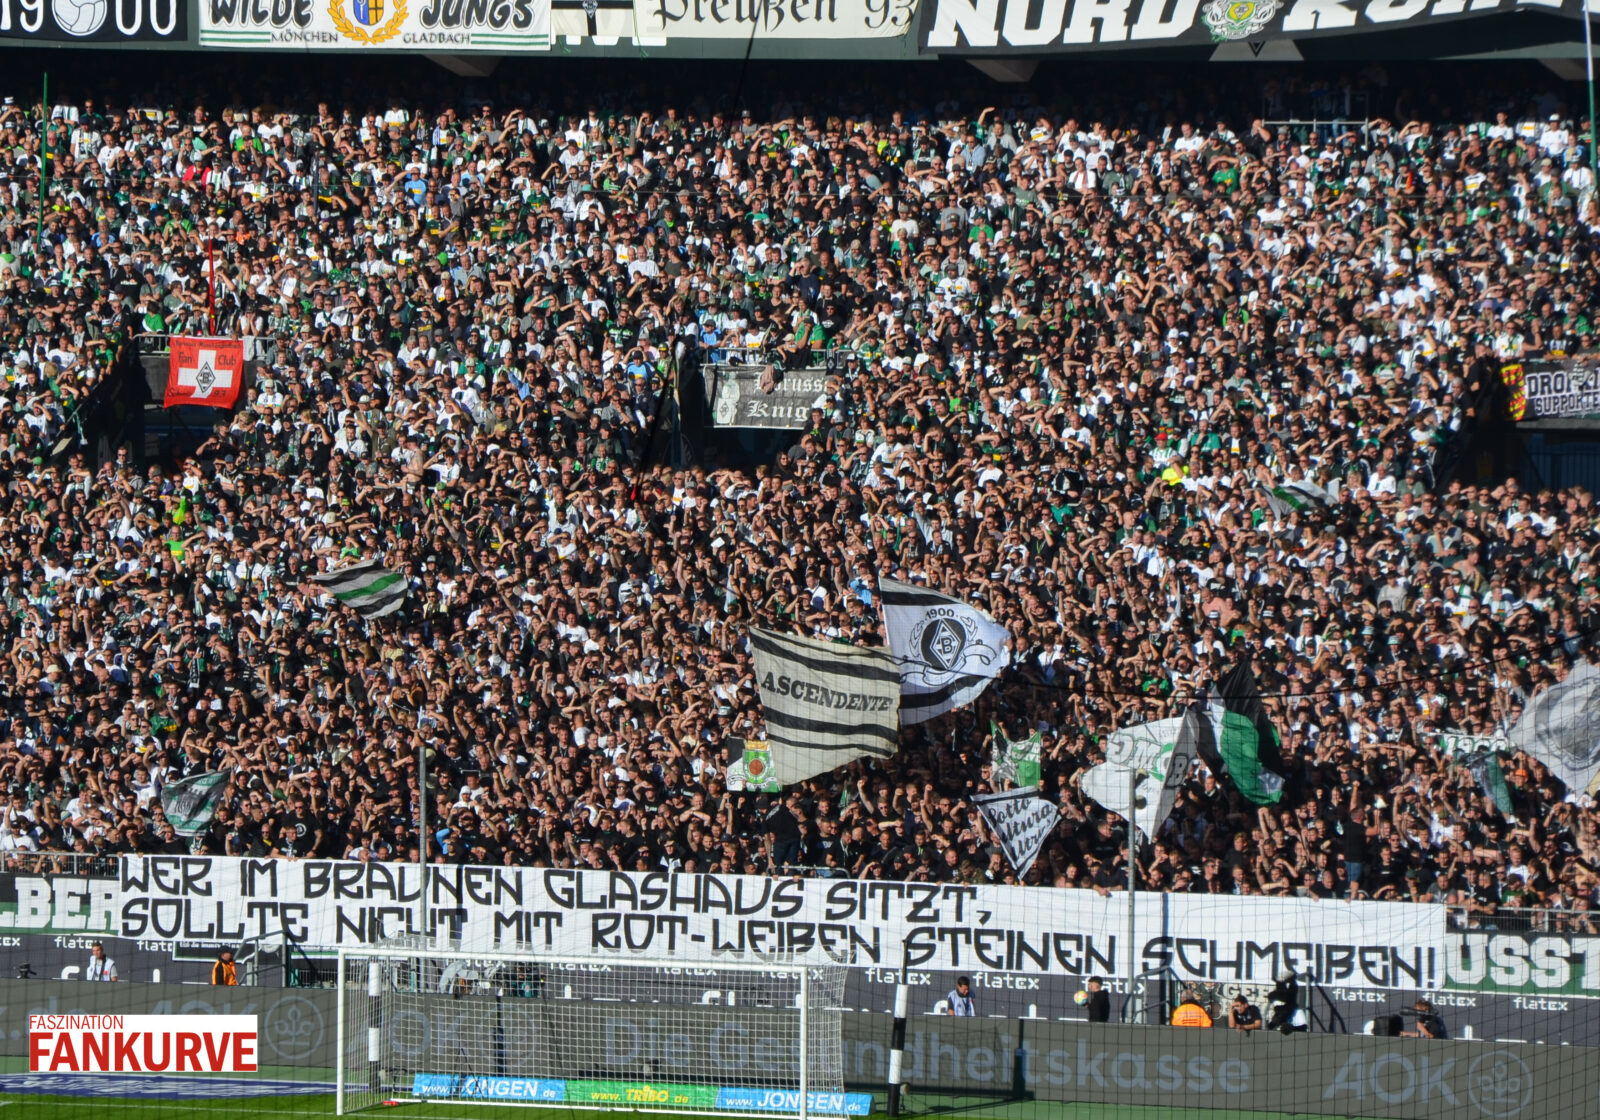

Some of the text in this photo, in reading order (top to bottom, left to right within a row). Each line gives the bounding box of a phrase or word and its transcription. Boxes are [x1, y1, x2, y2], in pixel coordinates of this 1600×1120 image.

[271, 29, 471, 45] MÖNCHEN GLADBACH
[747, 399, 810, 422] Knig
[926, 607, 955, 619] 1900
[761, 671, 893, 711] ASCENDENTE
[121, 857, 992, 925] WER IM BRAUNEN GLASHAUS SITZT,
[121, 897, 309, 943] SOLLTE
[494, 910, 563, 950] MIT
[904, 926, 1116, 975] STEINEN
[973, 971, 1039, 990] flatex
[1333, 988, 1386, 1003] flatex
[1422, 992, 1477, 1007] flatex
[1513, 996, 1569, 1011] flatex
[1323, 1051, 1461, 1106] AOK
